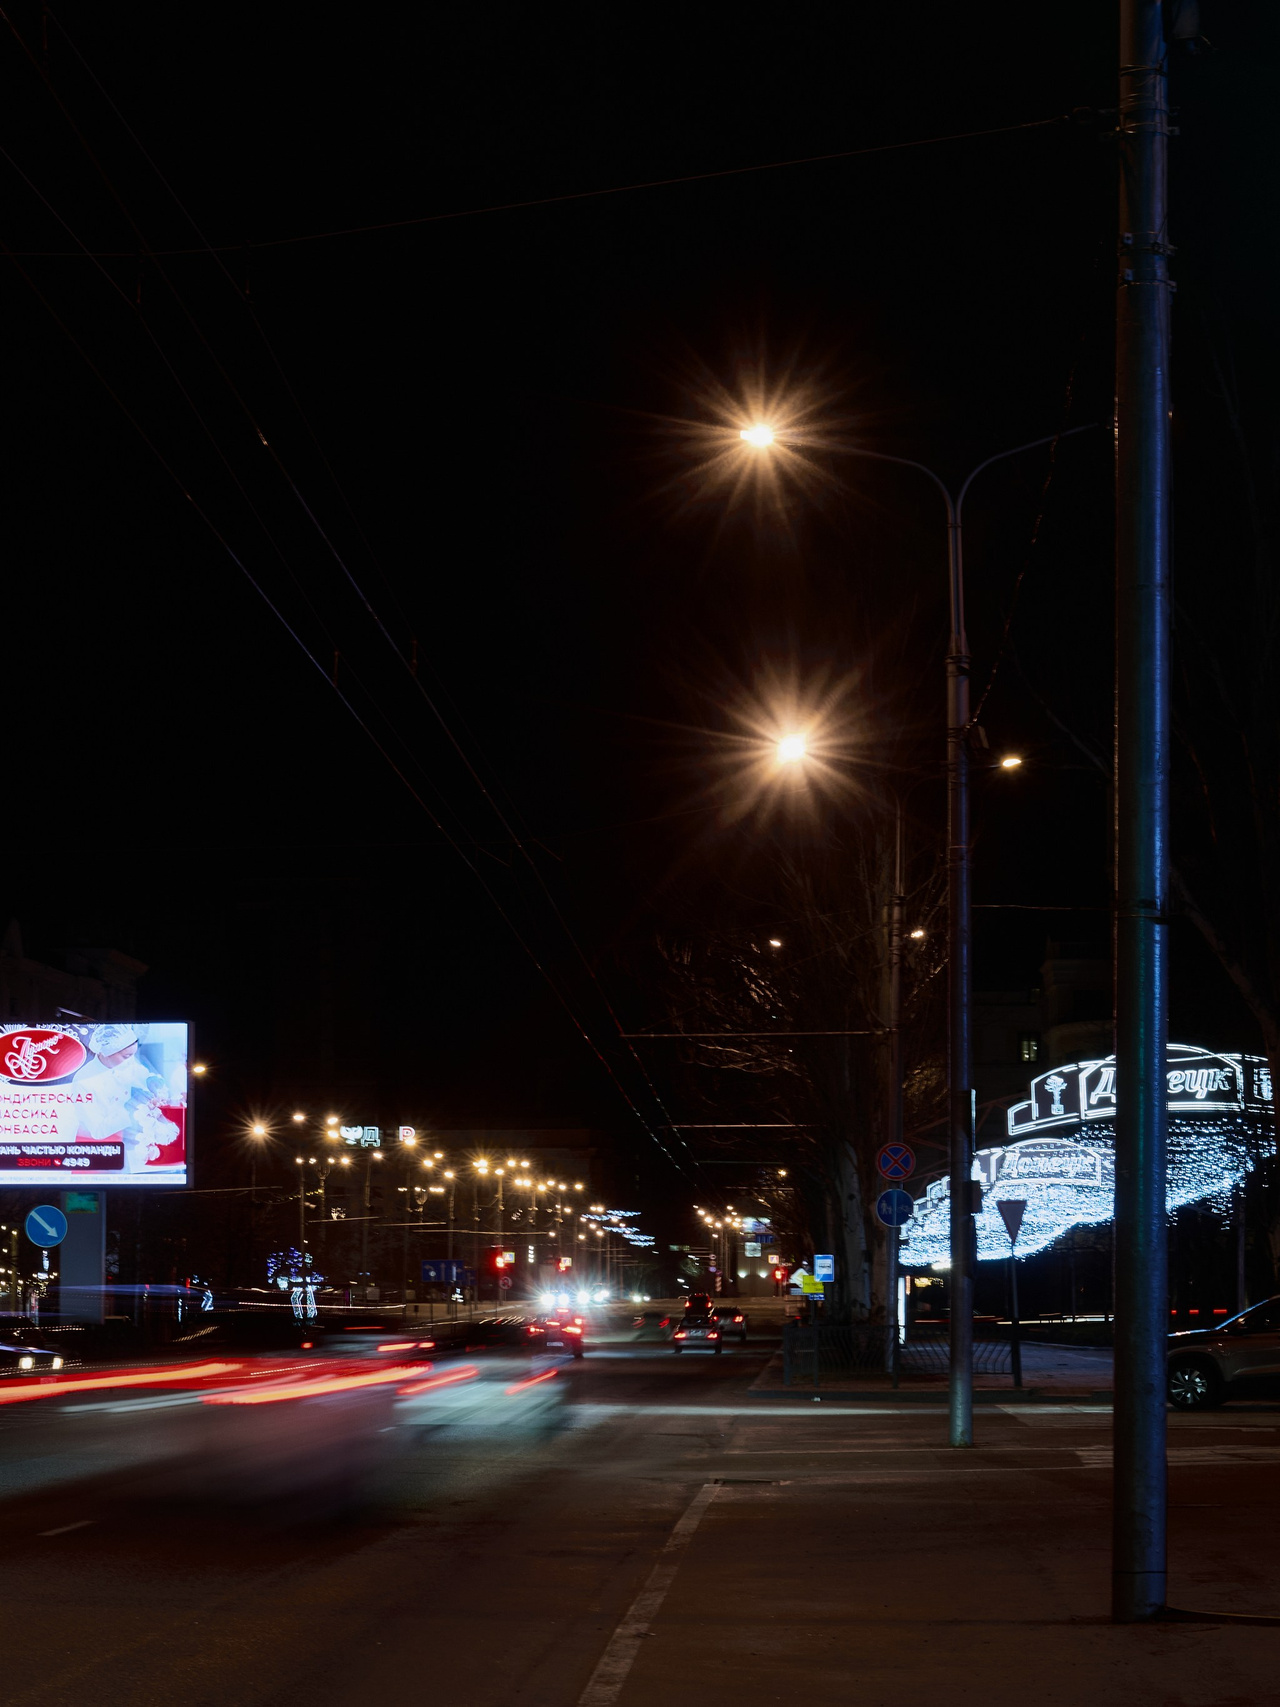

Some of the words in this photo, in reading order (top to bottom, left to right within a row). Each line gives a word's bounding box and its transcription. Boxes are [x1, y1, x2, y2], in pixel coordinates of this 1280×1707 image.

[1090, 1067, 1234, 1104] Децк
[22, 1145, 65, 1155] ЧАСТЬЮ
[67, 1145, 121, 1156] КОМАНДЫ
[17, 1158, 51, 1167] ЗВОНИ
[62, 1158, 90, 1167] 4949
